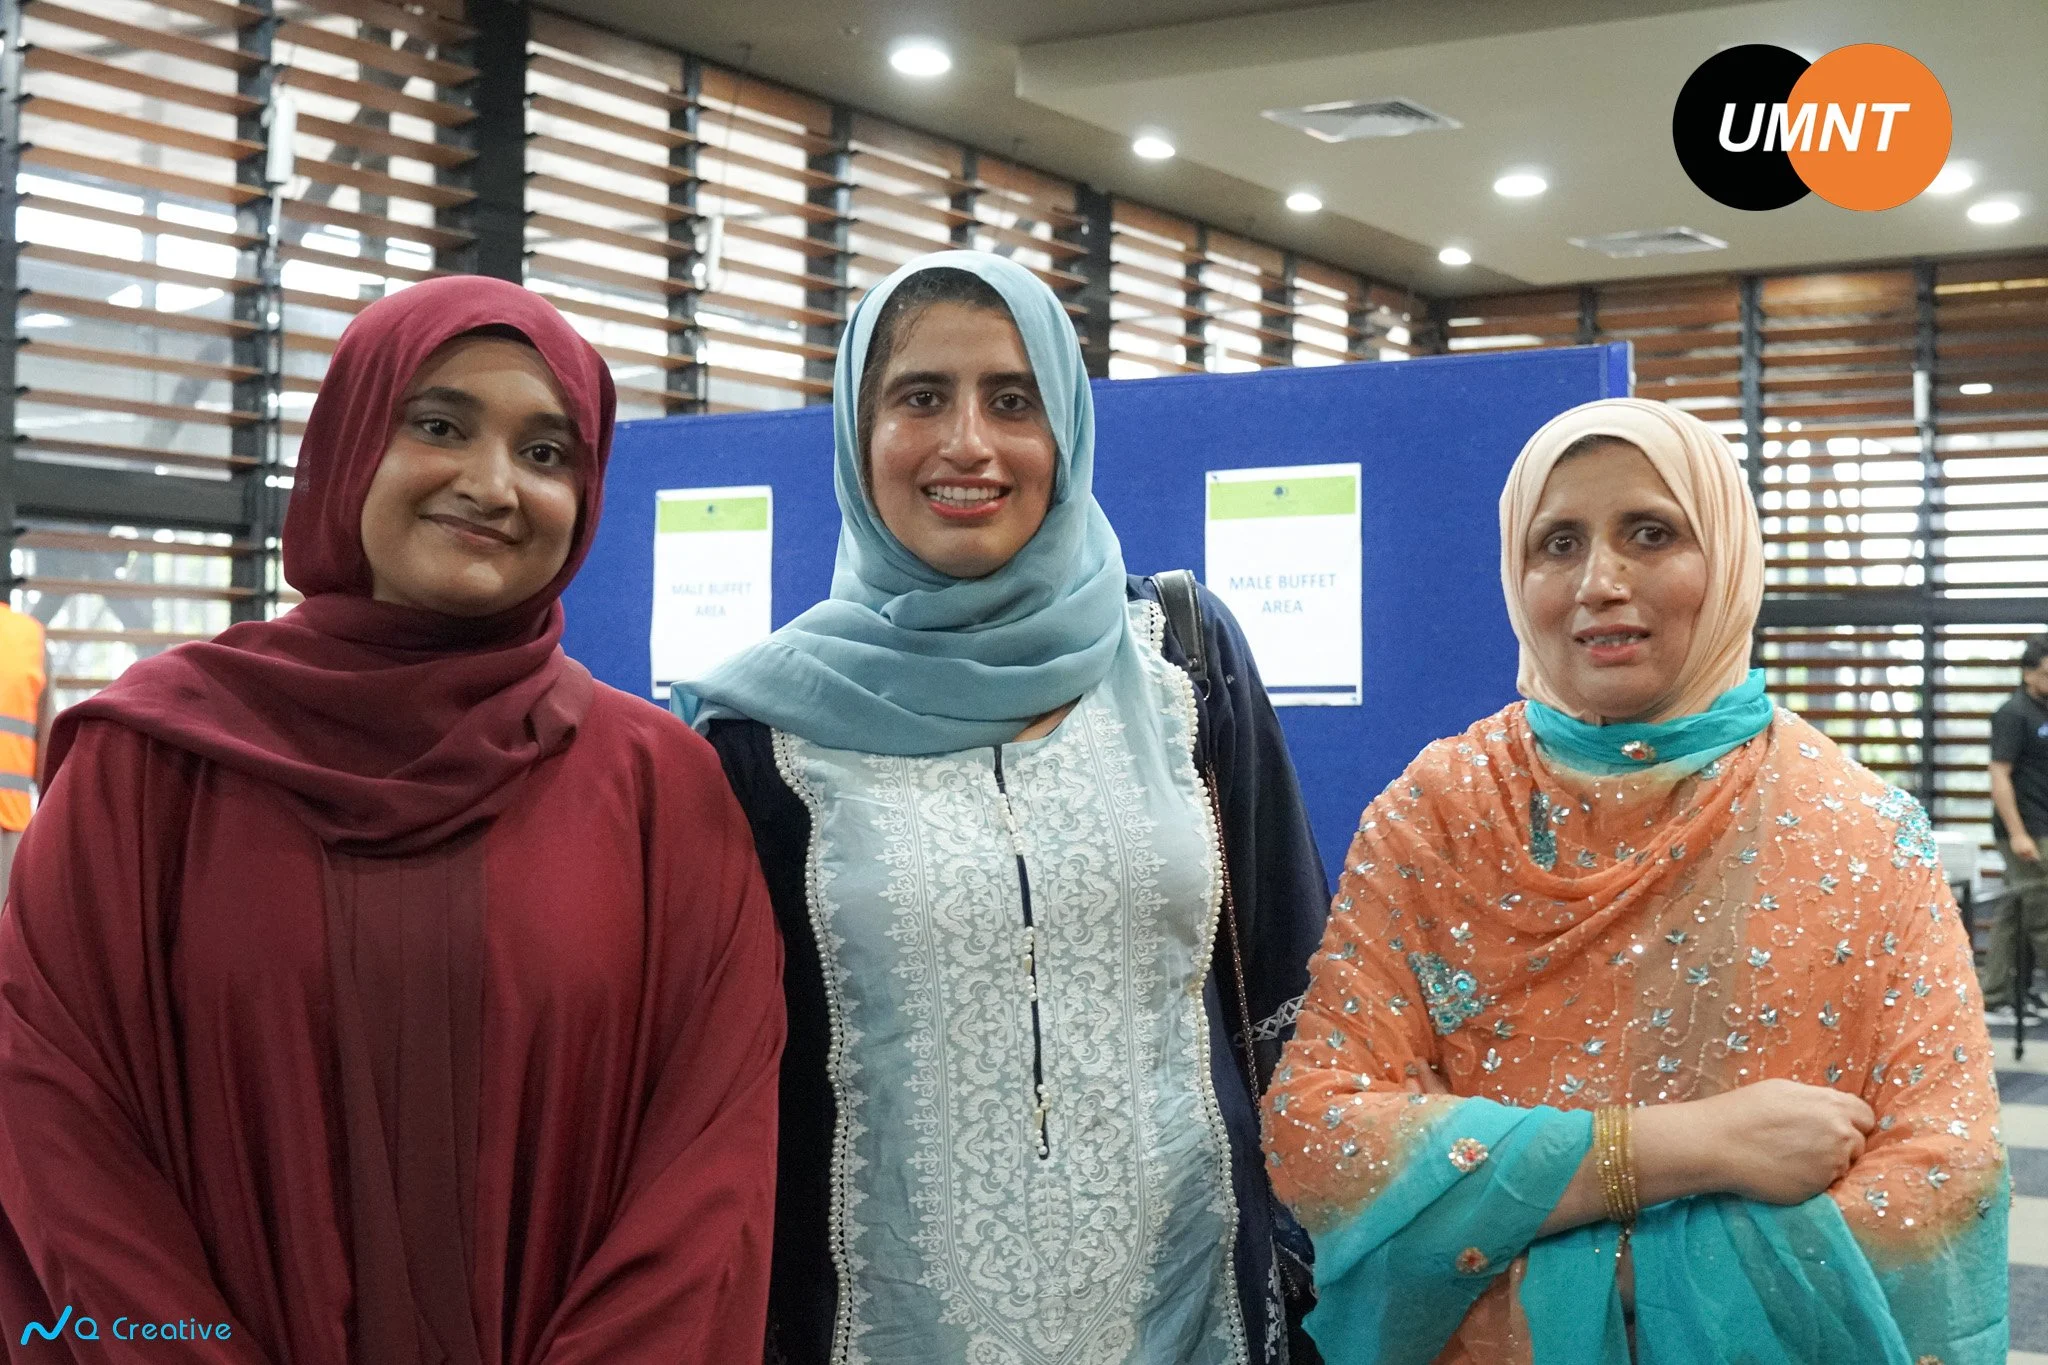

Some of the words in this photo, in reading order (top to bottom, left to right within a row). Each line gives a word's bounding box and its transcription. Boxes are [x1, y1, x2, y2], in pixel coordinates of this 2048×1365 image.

[1230, 575, 1273, 591] MALE
[1278, 572, 1337, 590] BUFFET
[1262, 599, 1304, 614] AREA
